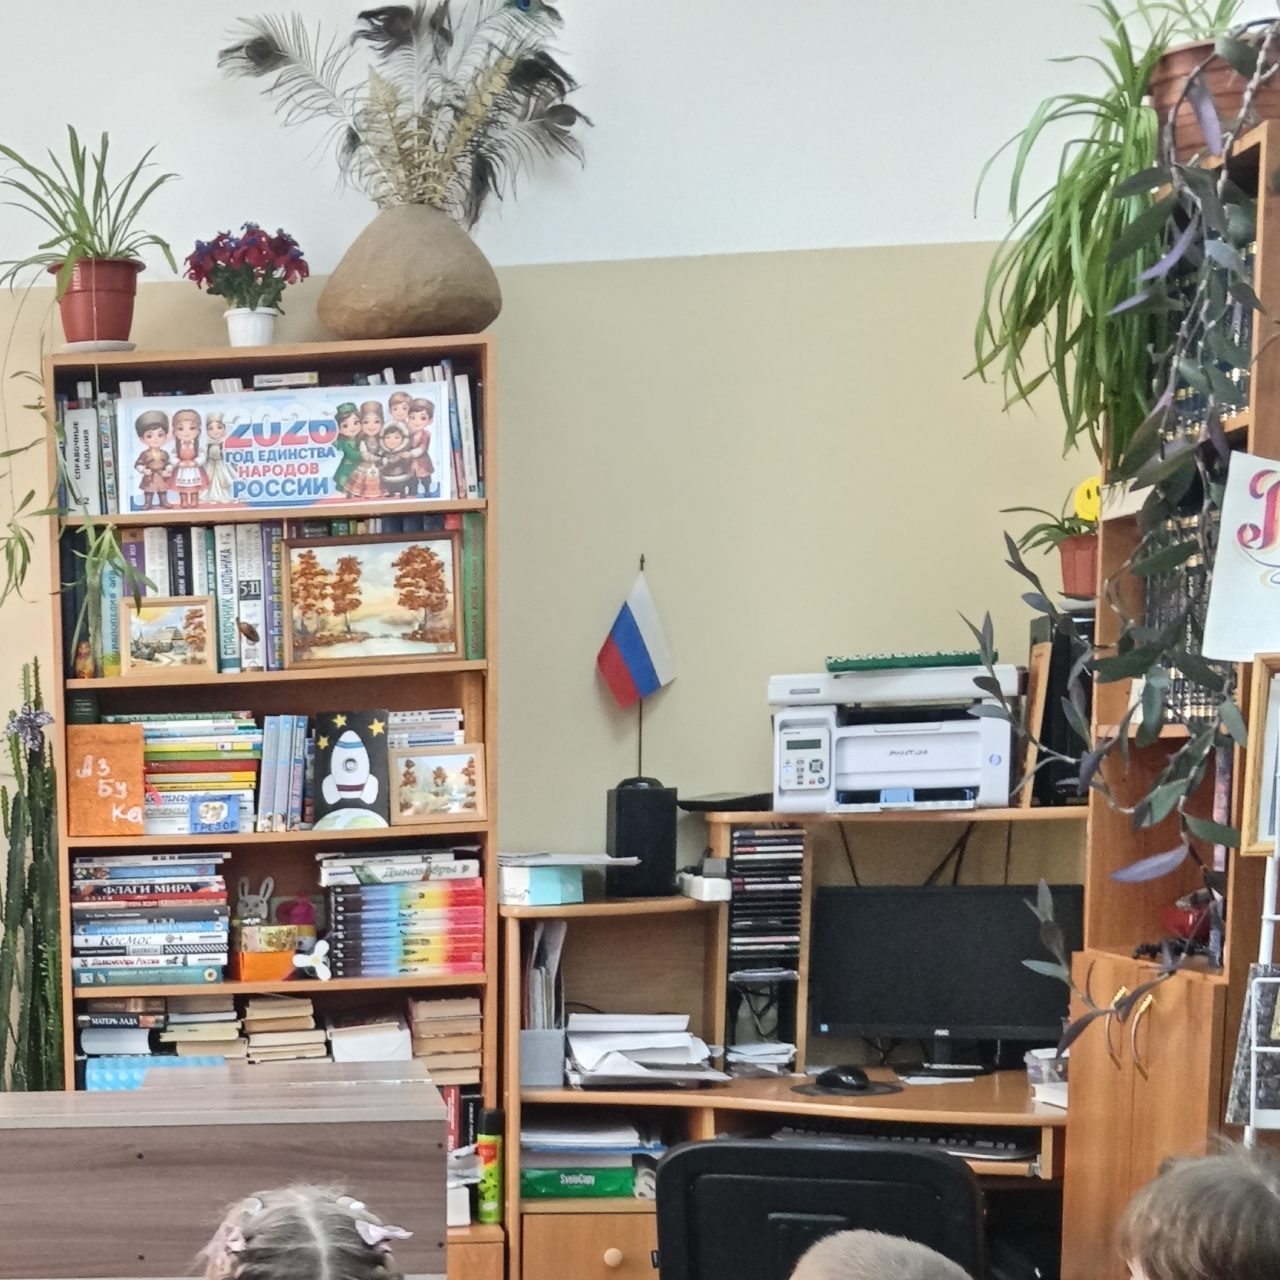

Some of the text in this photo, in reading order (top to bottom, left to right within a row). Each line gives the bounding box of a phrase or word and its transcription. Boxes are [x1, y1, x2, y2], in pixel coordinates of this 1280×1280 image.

[223, 403, 338, 449] 2026
[73, 421, 81, 480] СПРАВОЧНЫЕ
[83, 429, 91, 470] ИЗДАНИЯ
[225, 446, 336, 463] ГОД ЕДИНСТВА
[238, 462, 320, 478] НАРОДОВ
[232, 476, 329, 498] РОССИИ
[220, 548, 236, 656] СПРАВОЧНИК ШКОЛЬНИКА
[102, 882, 193, 896] ФЛАГИ МИРА
[559, 1173, 595, 1186] SvetoCopy
